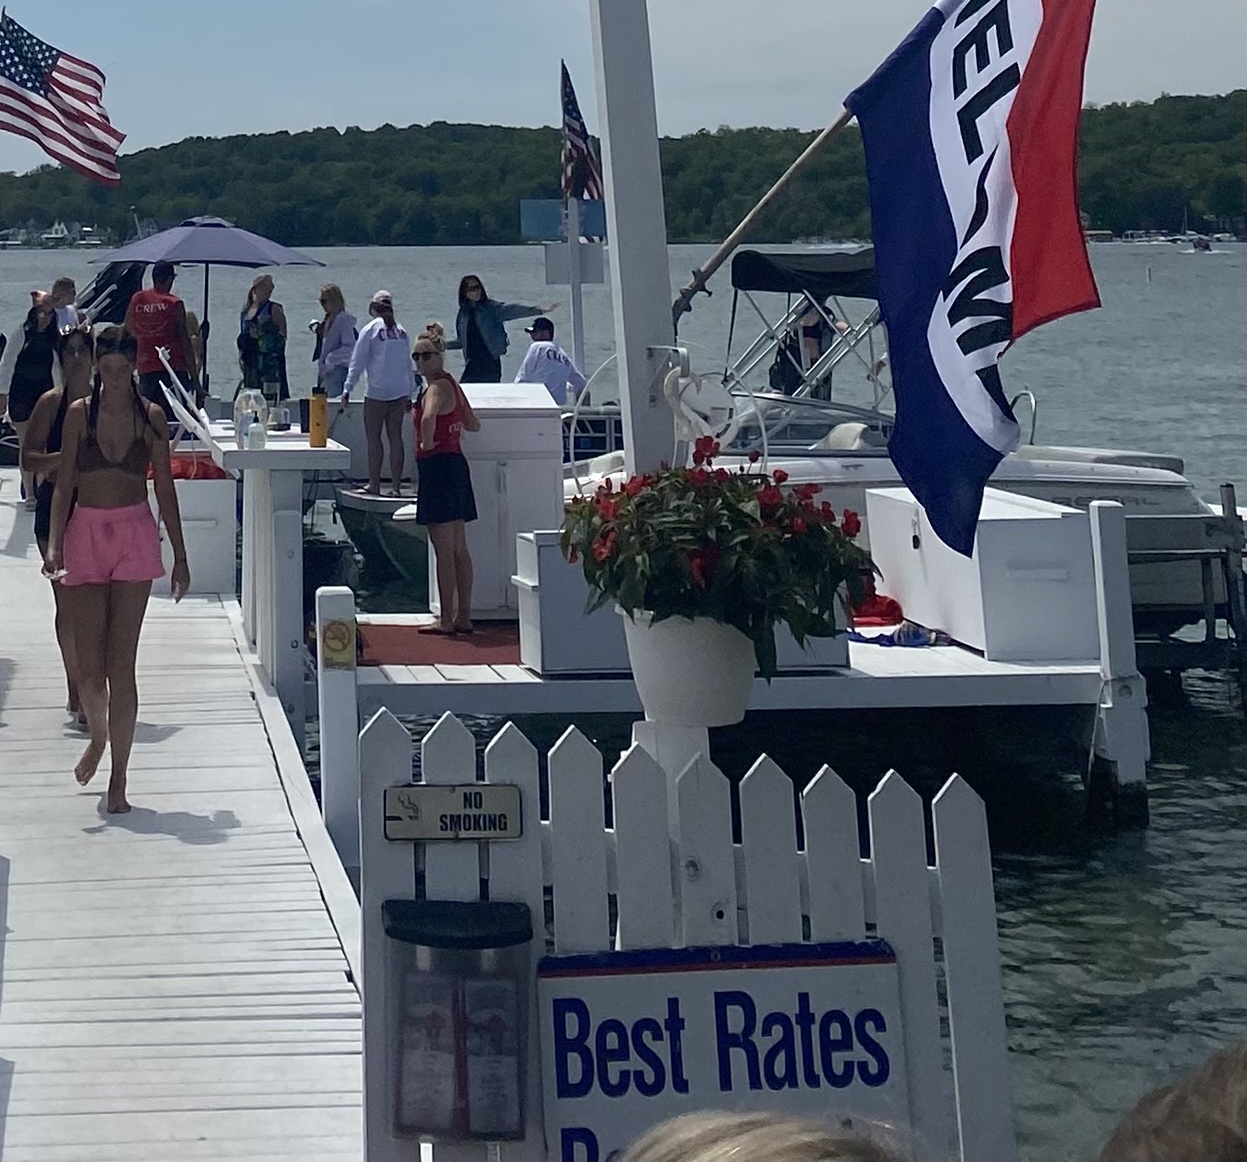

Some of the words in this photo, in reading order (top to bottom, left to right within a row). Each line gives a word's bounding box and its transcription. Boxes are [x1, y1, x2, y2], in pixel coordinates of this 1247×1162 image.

[462, 791, 483, 810] NO
[439, 813, 508, 831] SMOKING
[552, 997, 689, 1099] Best
[714, 990, 890, 1091] Rates
